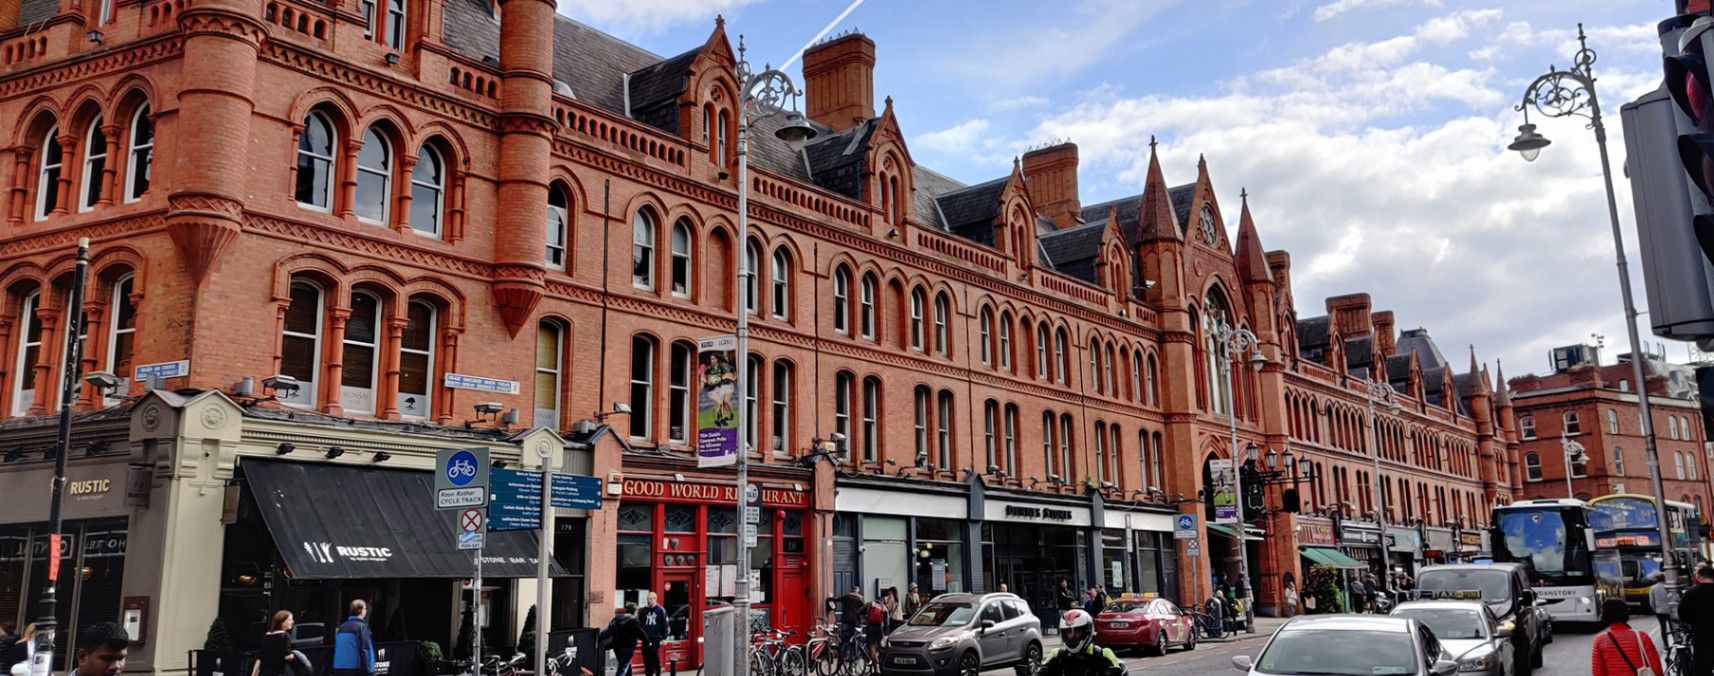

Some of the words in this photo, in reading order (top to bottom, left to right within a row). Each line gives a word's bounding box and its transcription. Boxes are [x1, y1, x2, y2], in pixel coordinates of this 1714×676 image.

[70, 479, 111, 495] RUSTIC
[624, 479, 664, 497] GOOD
[670, 483, 719, 499] WORLD
[724, 486, 805, 505] RURANT
[335, 546, 393, 558] RUSTIC
